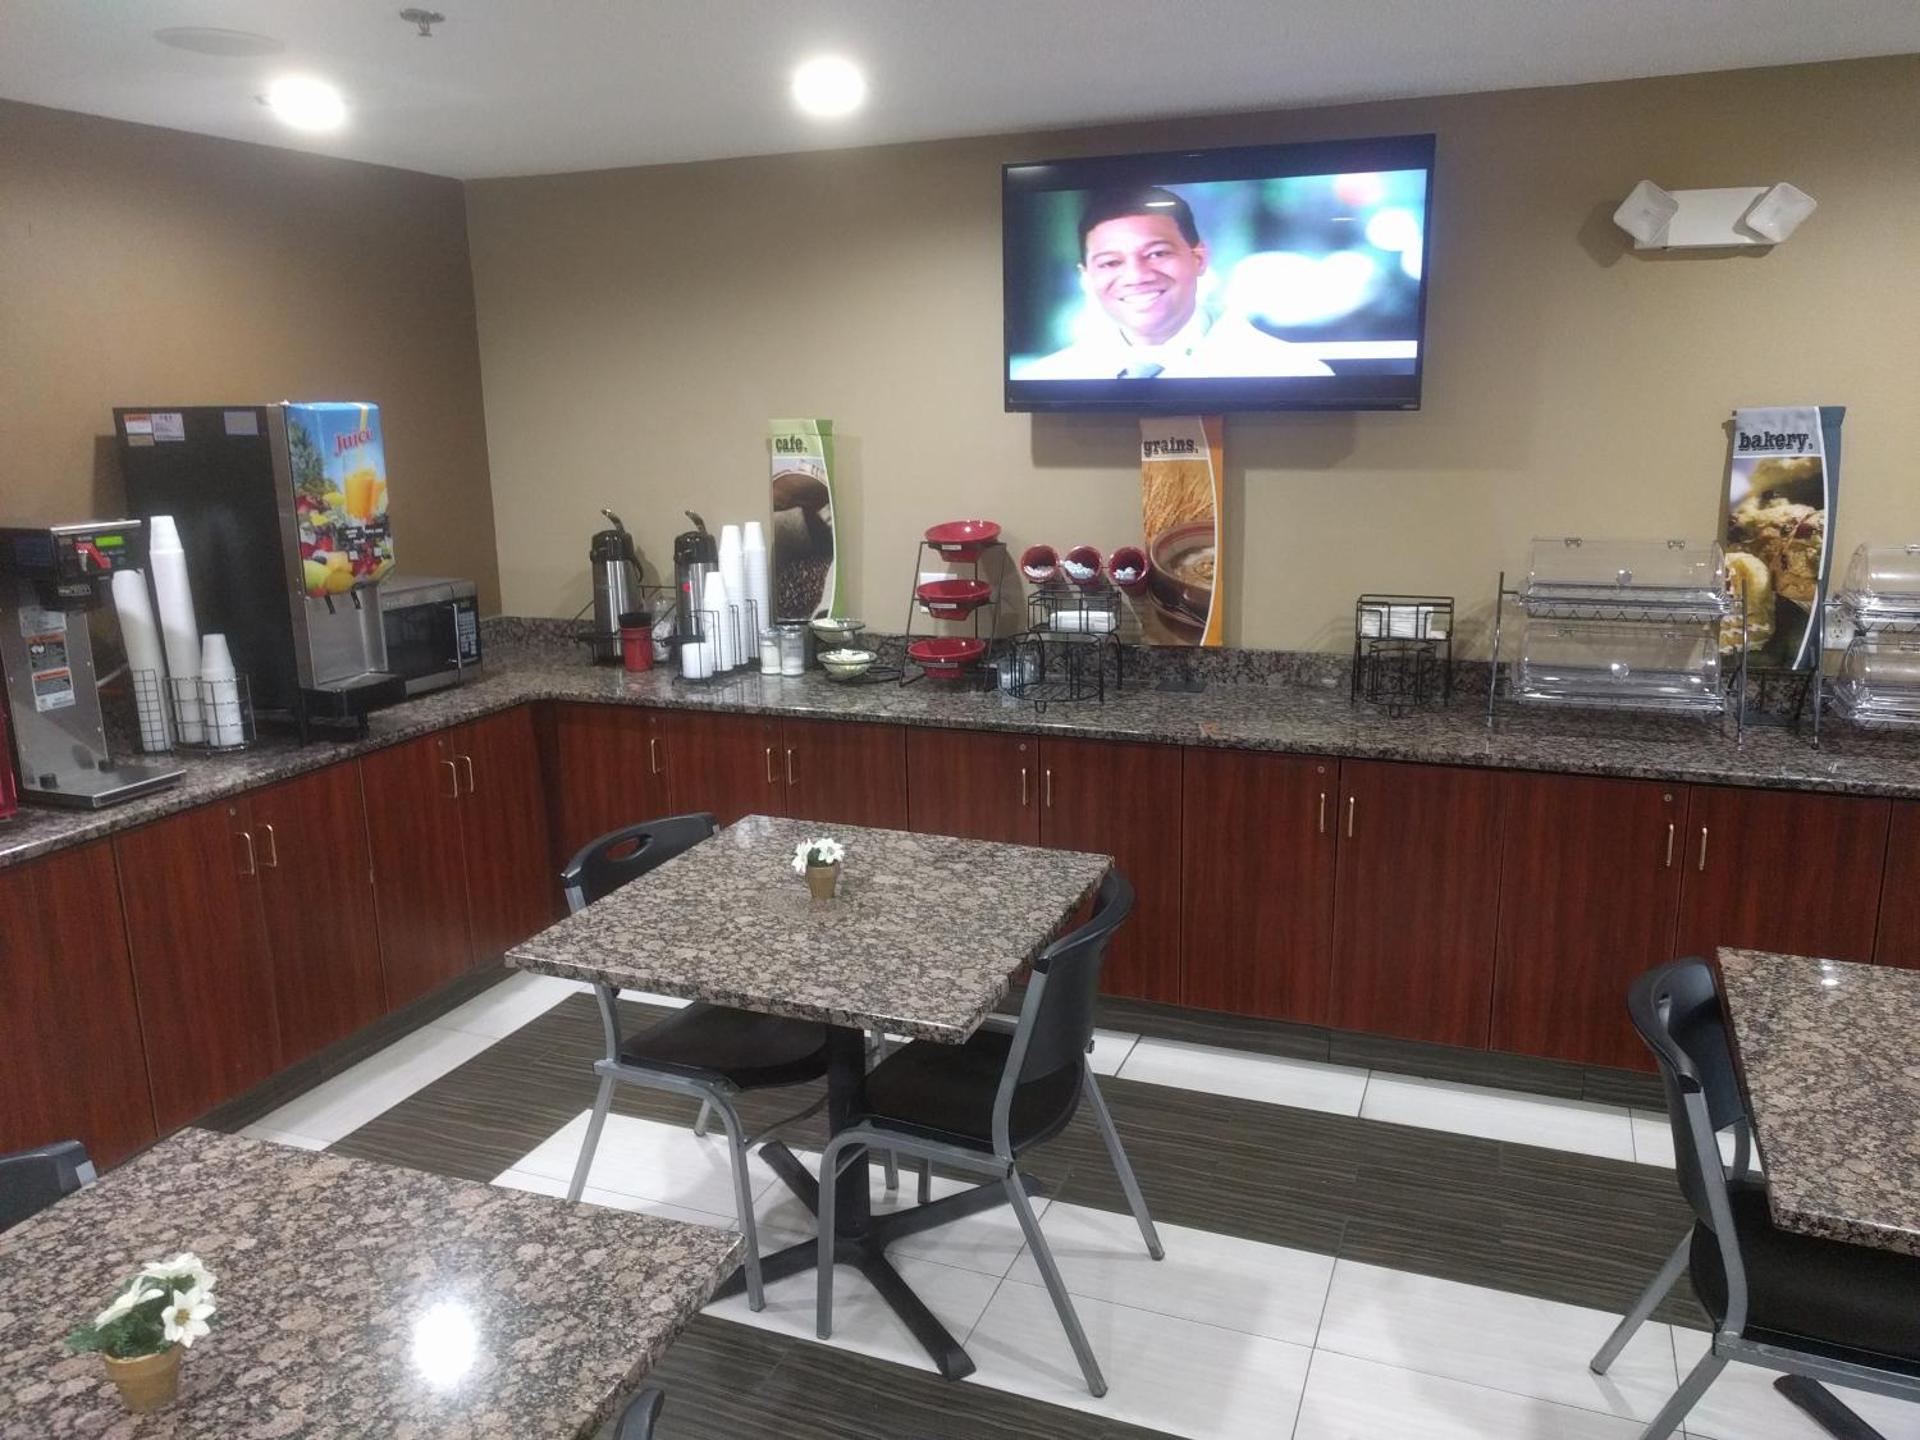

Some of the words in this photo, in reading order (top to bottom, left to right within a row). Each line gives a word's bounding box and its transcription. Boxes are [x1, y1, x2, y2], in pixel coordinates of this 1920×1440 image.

[775, 434, 808, 453] cafe.
[1143, 436, 1199, 457] grains.
[1738, 431, 1814, 453] bakery.
